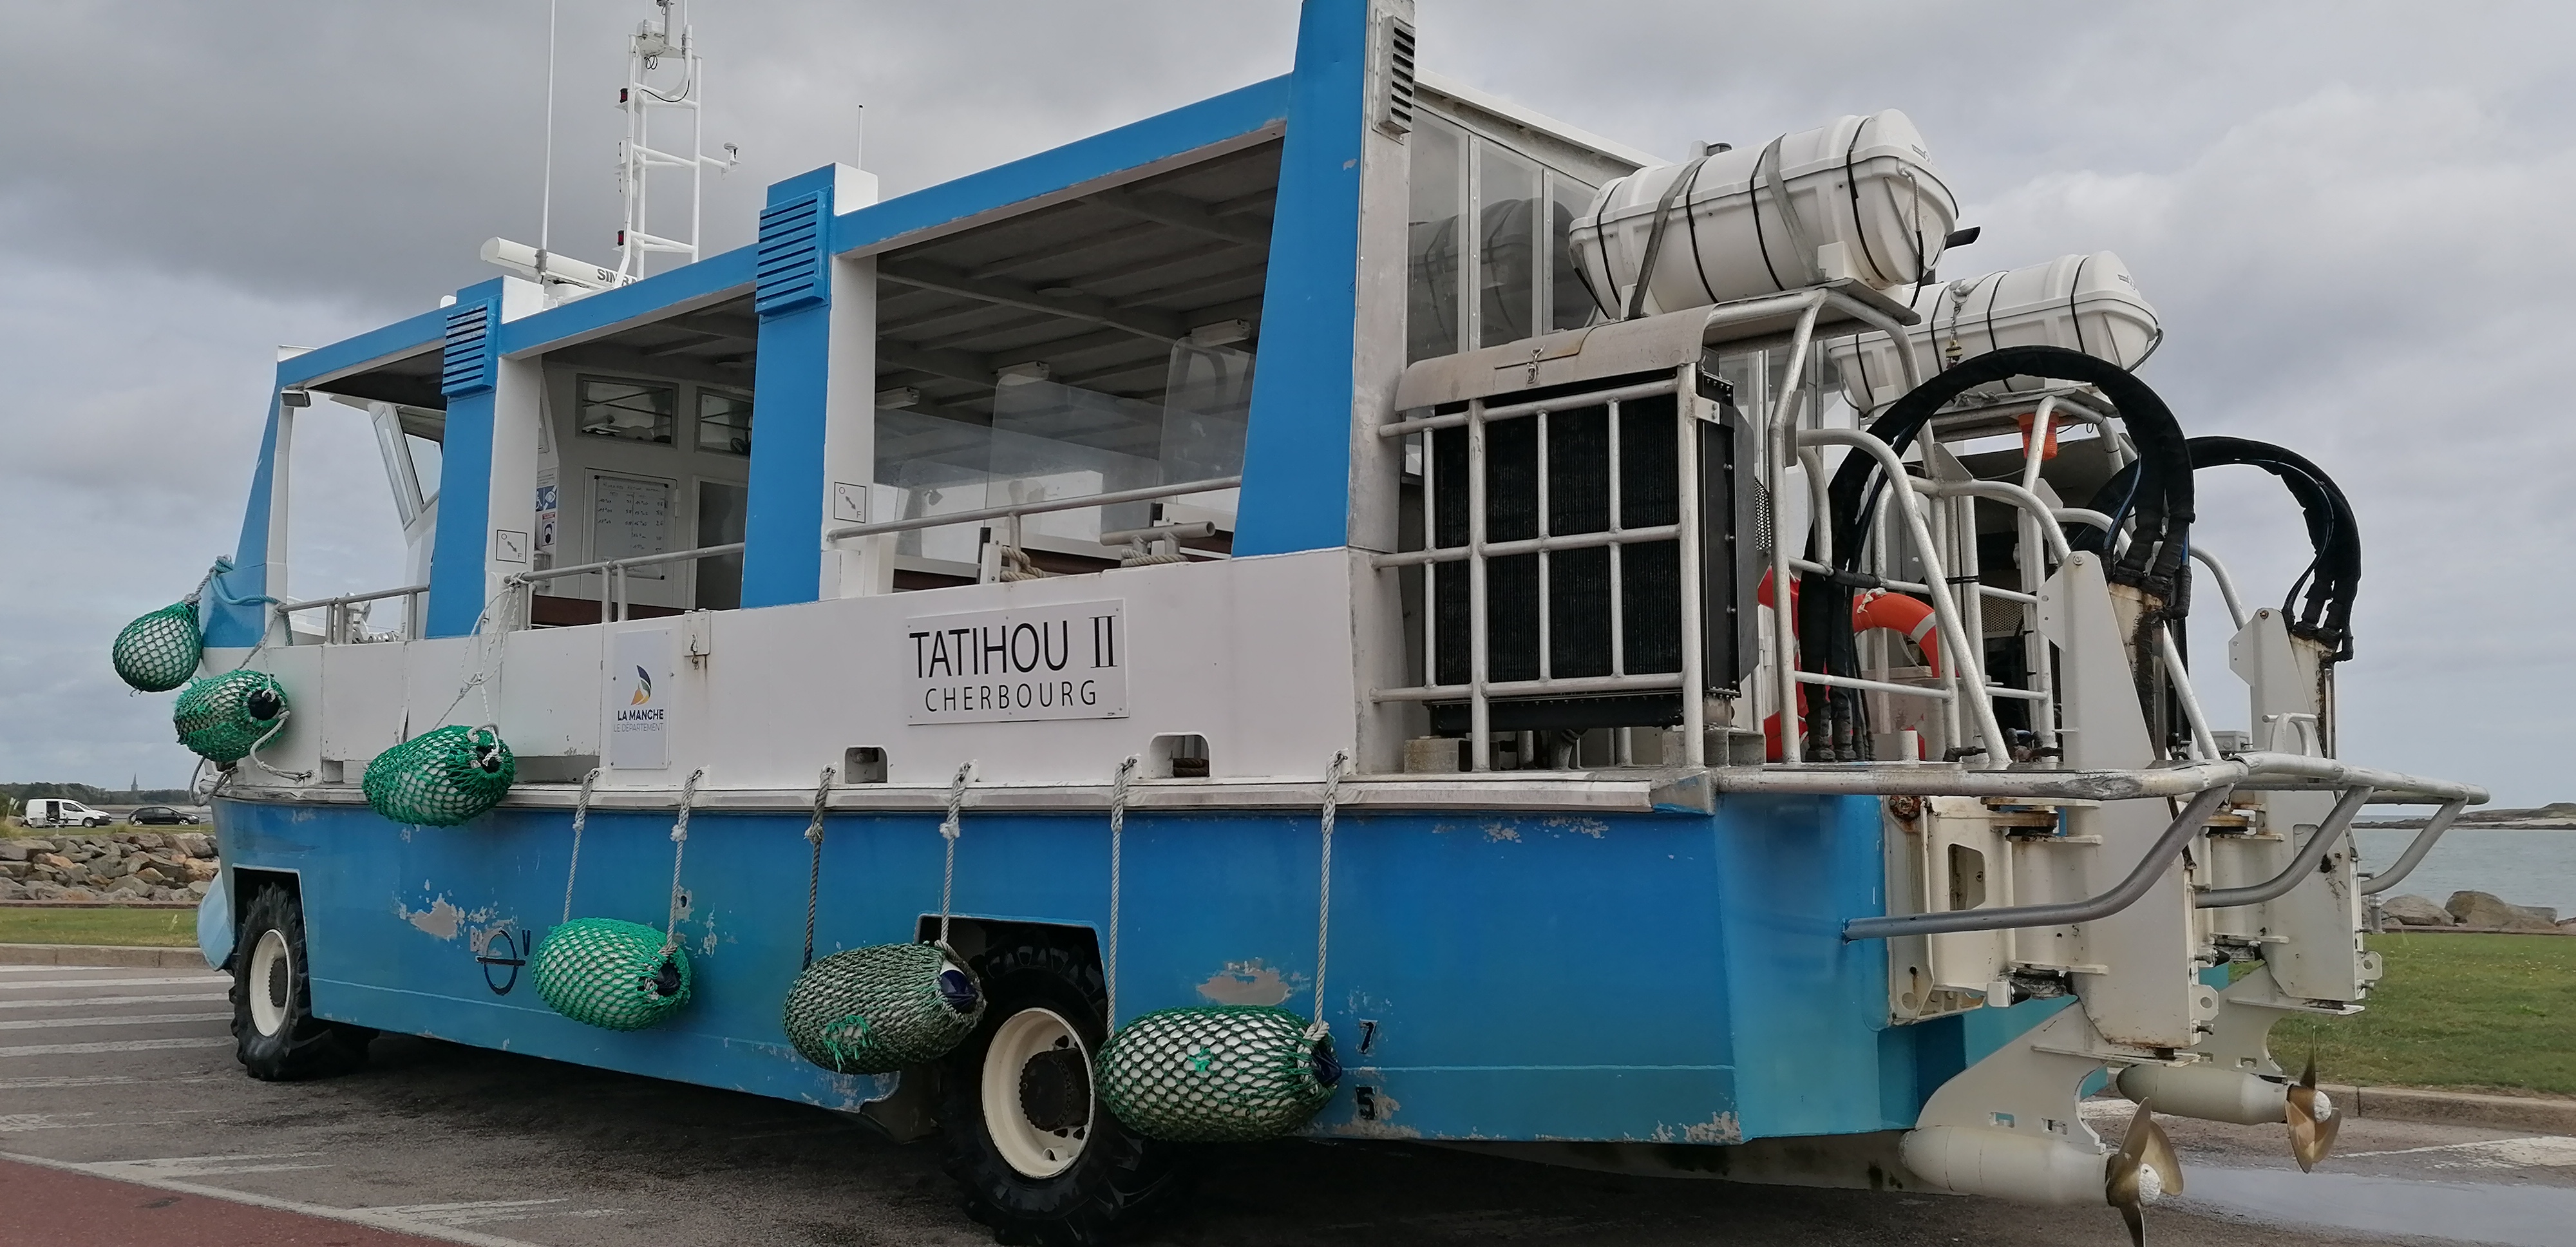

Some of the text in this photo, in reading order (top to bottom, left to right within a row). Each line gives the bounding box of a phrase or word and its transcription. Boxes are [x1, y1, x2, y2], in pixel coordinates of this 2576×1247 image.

[909, 615, 1118, 678] TATIHOU II
[925, 680, 1096, 712] CHERBOURG
[614, 724, 621, 732] LE
[618, 709, 664, 721] LA MANCHE
[1359, 1019, 1378, 1054] 7
